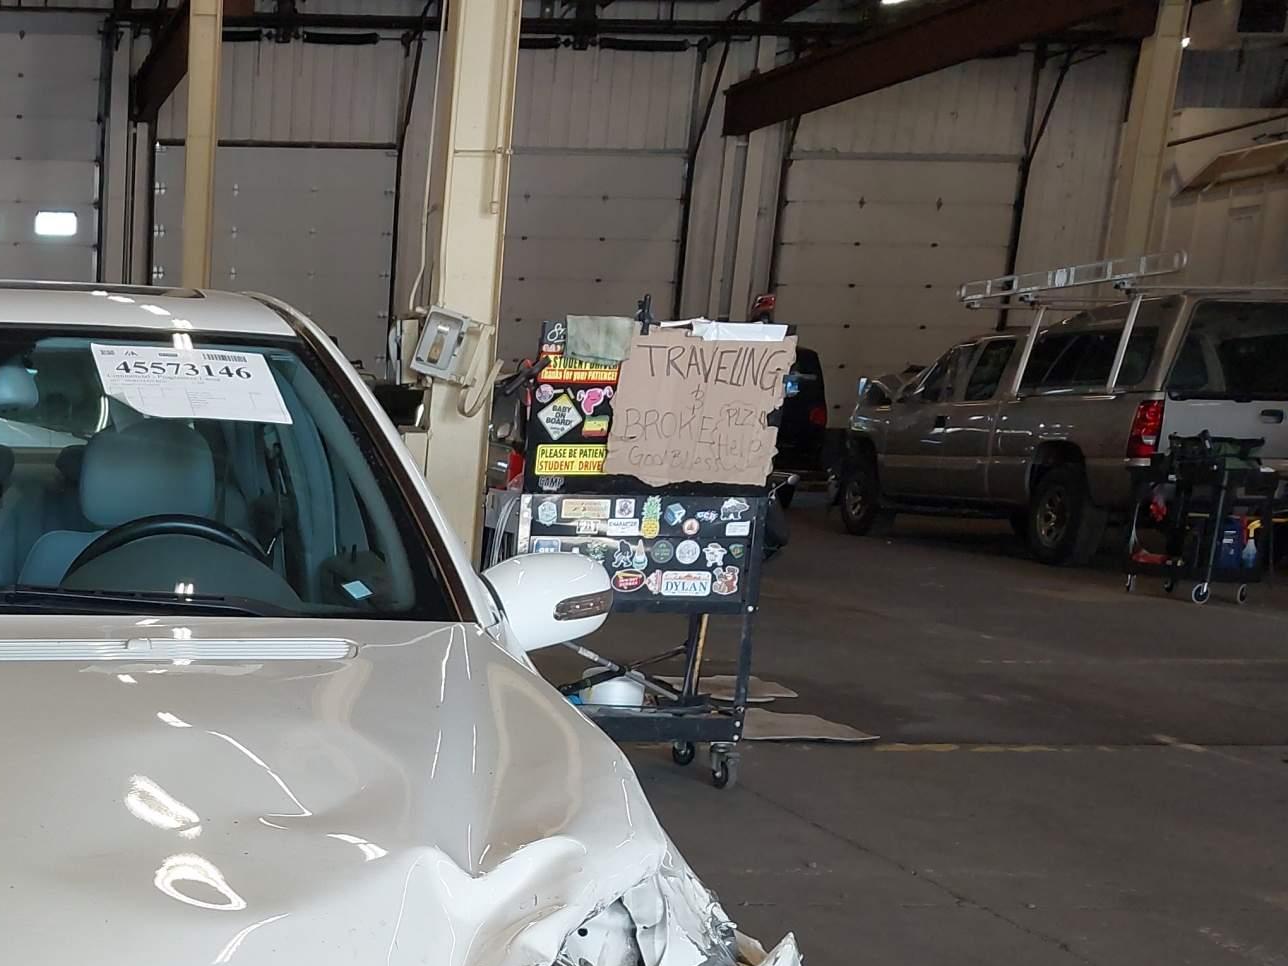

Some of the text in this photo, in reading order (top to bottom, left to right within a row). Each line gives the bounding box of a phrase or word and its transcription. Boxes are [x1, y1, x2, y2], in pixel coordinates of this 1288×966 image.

[115, 360, 252, 380] 45573146
[636, 344, 788, 396] TRAVELING
[552, 405, 572, 414] BABY
[554, 411, 566, 419] ON
[540, 448, 605, 459] PLEASE BE PATIEN
[539, 460, 603, 472] STUDENT DRIVE
[665, 580, 708, 592] DYLAN
